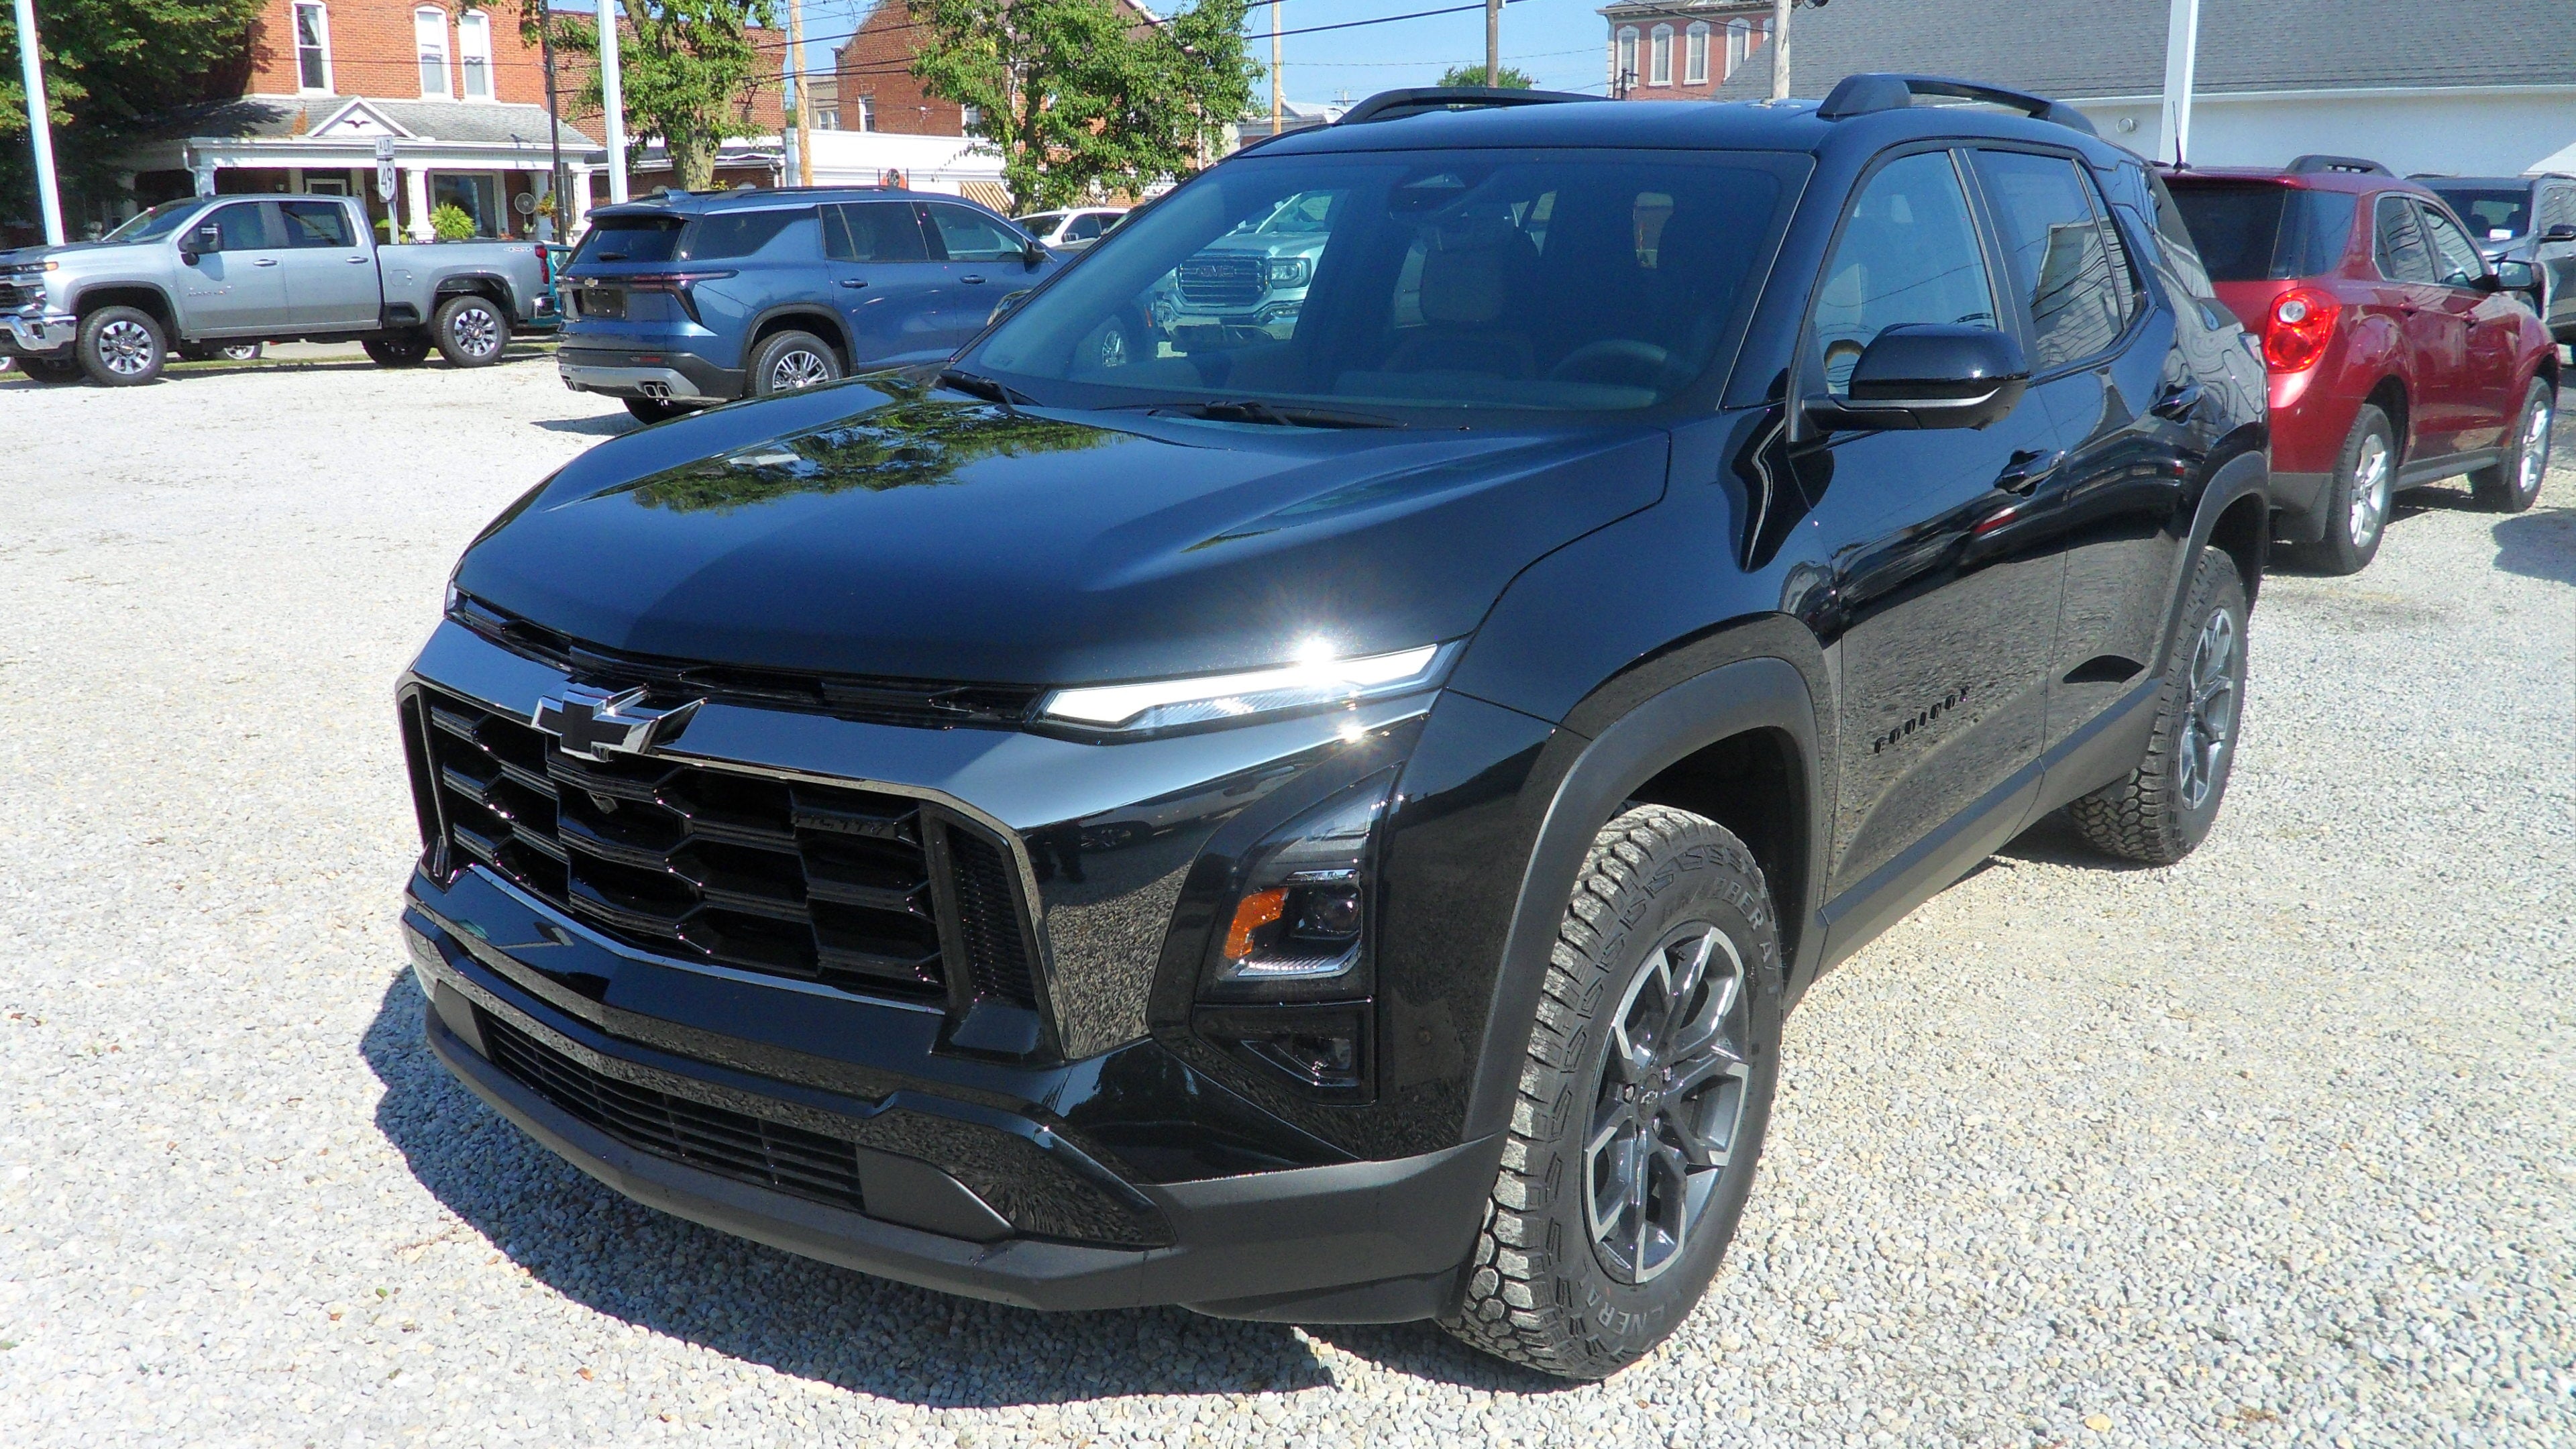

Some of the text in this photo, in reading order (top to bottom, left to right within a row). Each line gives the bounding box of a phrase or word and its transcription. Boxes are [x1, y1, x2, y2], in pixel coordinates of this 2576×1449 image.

[379, 140, 390, 152] ALT
[381, 167, 392, 191] 49
[1198, 265, 1234, 277] GMC
